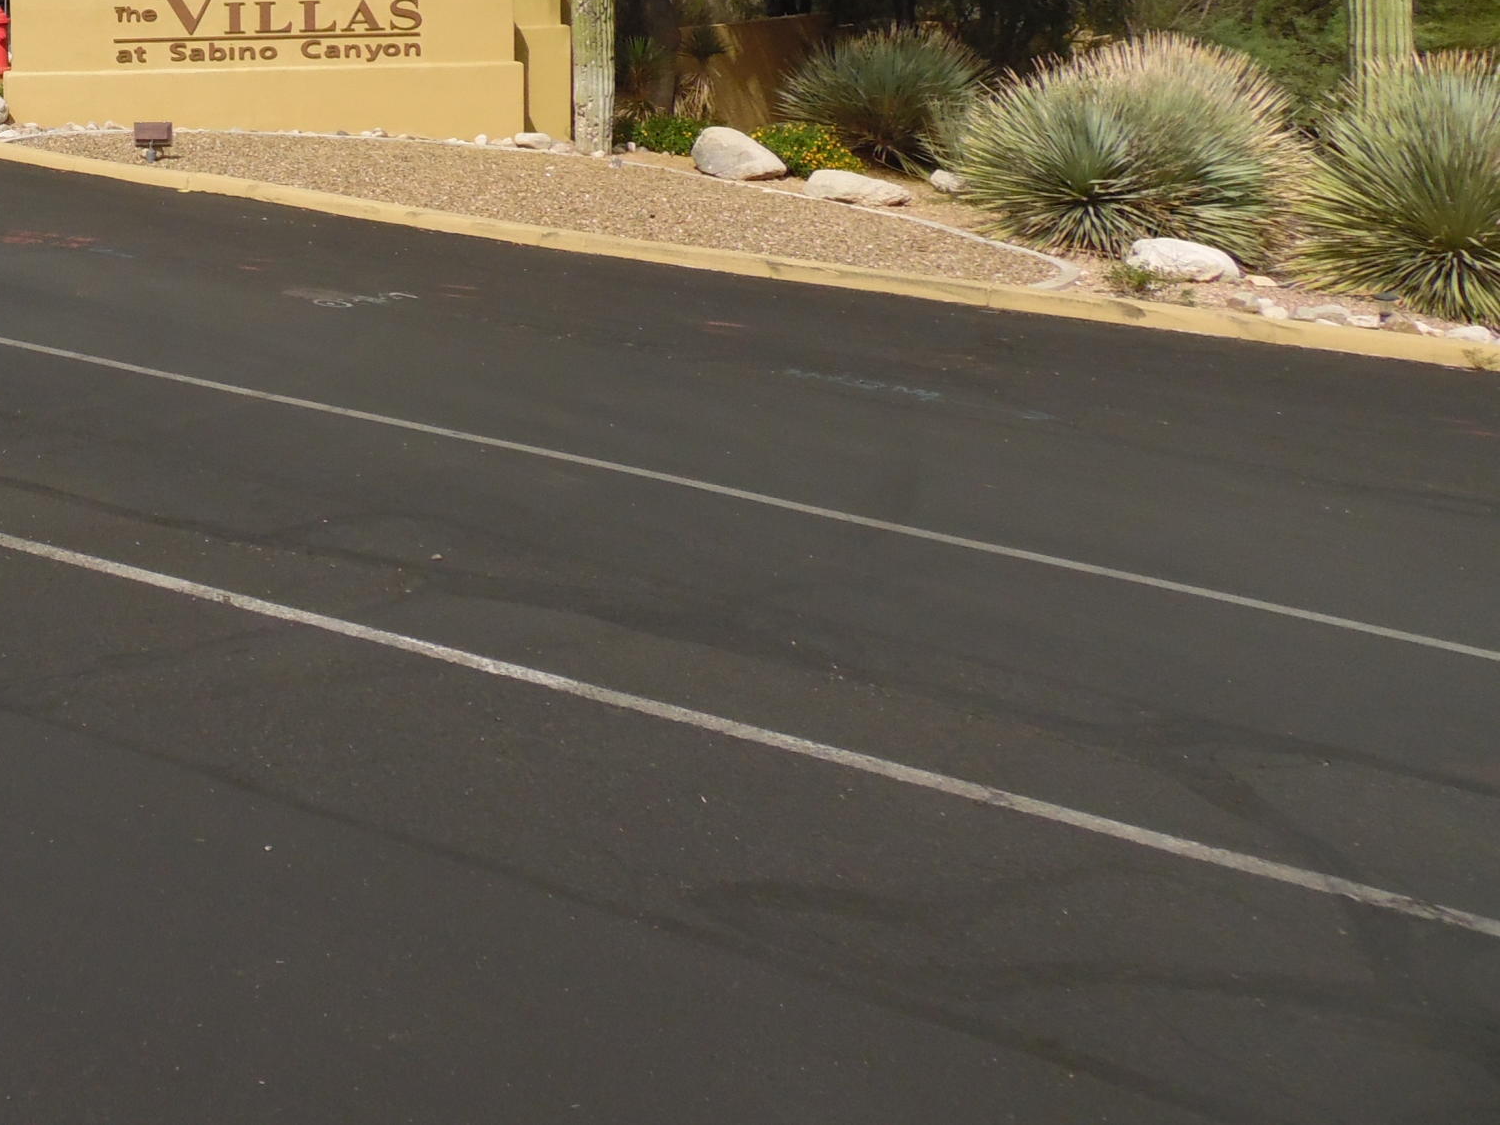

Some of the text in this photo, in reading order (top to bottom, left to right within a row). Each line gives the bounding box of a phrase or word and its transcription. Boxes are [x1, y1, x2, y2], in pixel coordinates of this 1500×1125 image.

[115, 6, 158, 23] The
[116, 40, 422, 63] at Sabino Canyon
